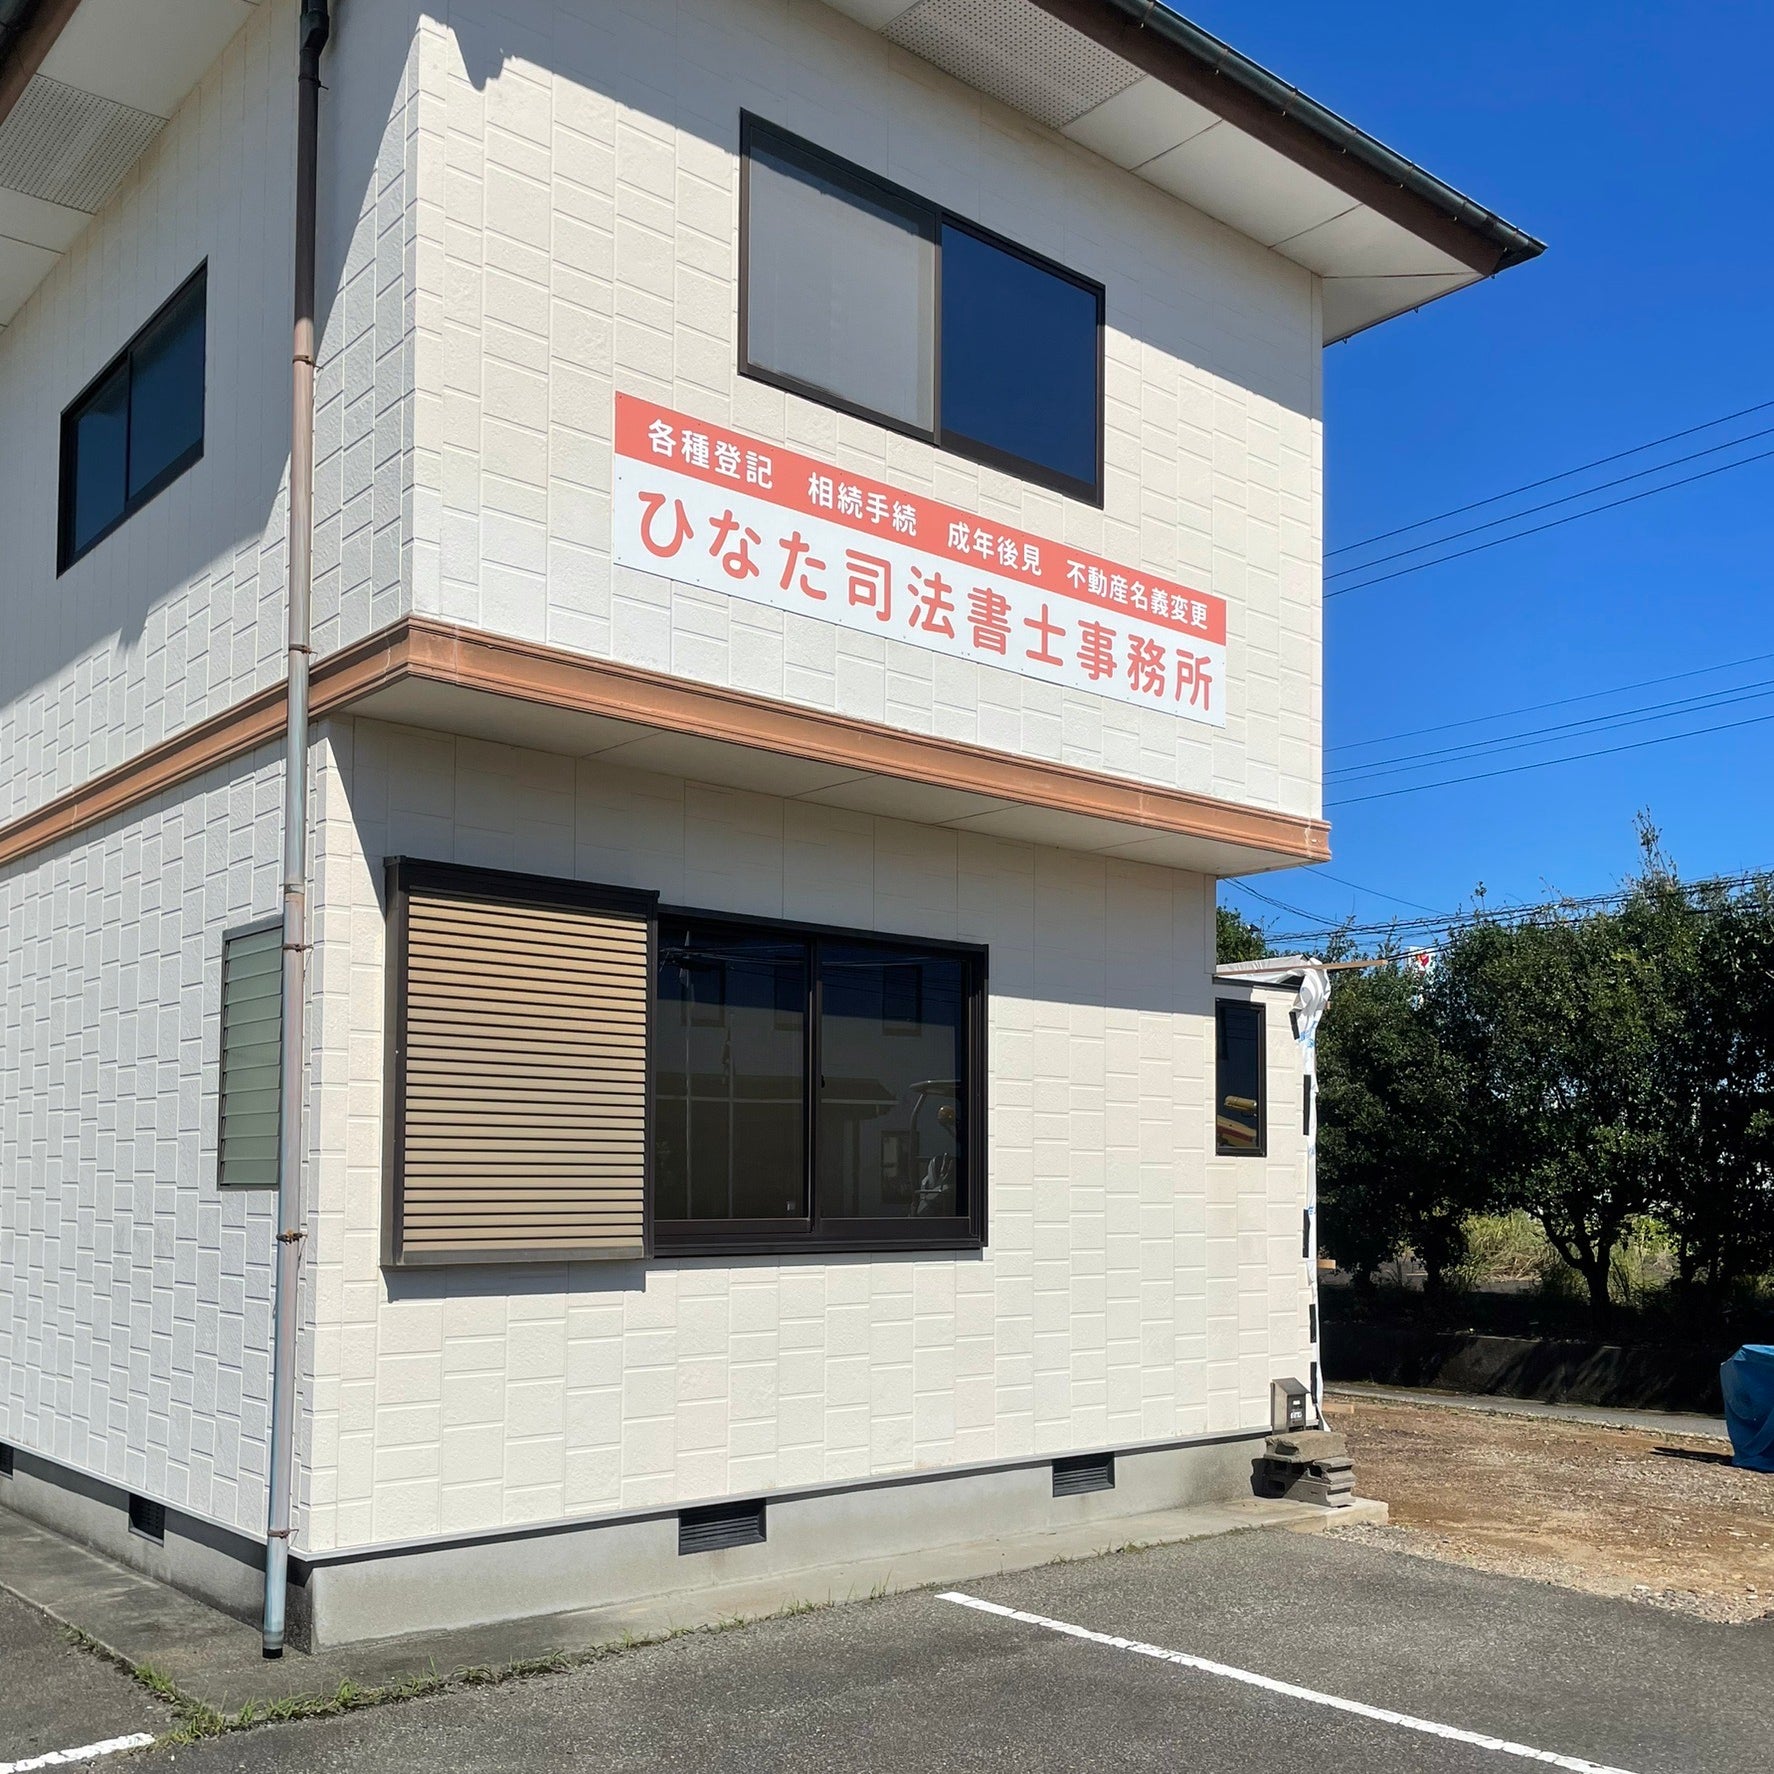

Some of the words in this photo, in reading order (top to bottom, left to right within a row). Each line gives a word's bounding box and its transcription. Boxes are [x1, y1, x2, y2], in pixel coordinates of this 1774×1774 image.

[638, 491, 1213, 711] ひなた司法書士事務所
[648, 418, 773, 489] 各種登記
[807, 471, 917, 536] 相続手続
[947, 521, 1042, 576] 成年後見
[1066, 559, 1208, 630] 不動産名義変更
